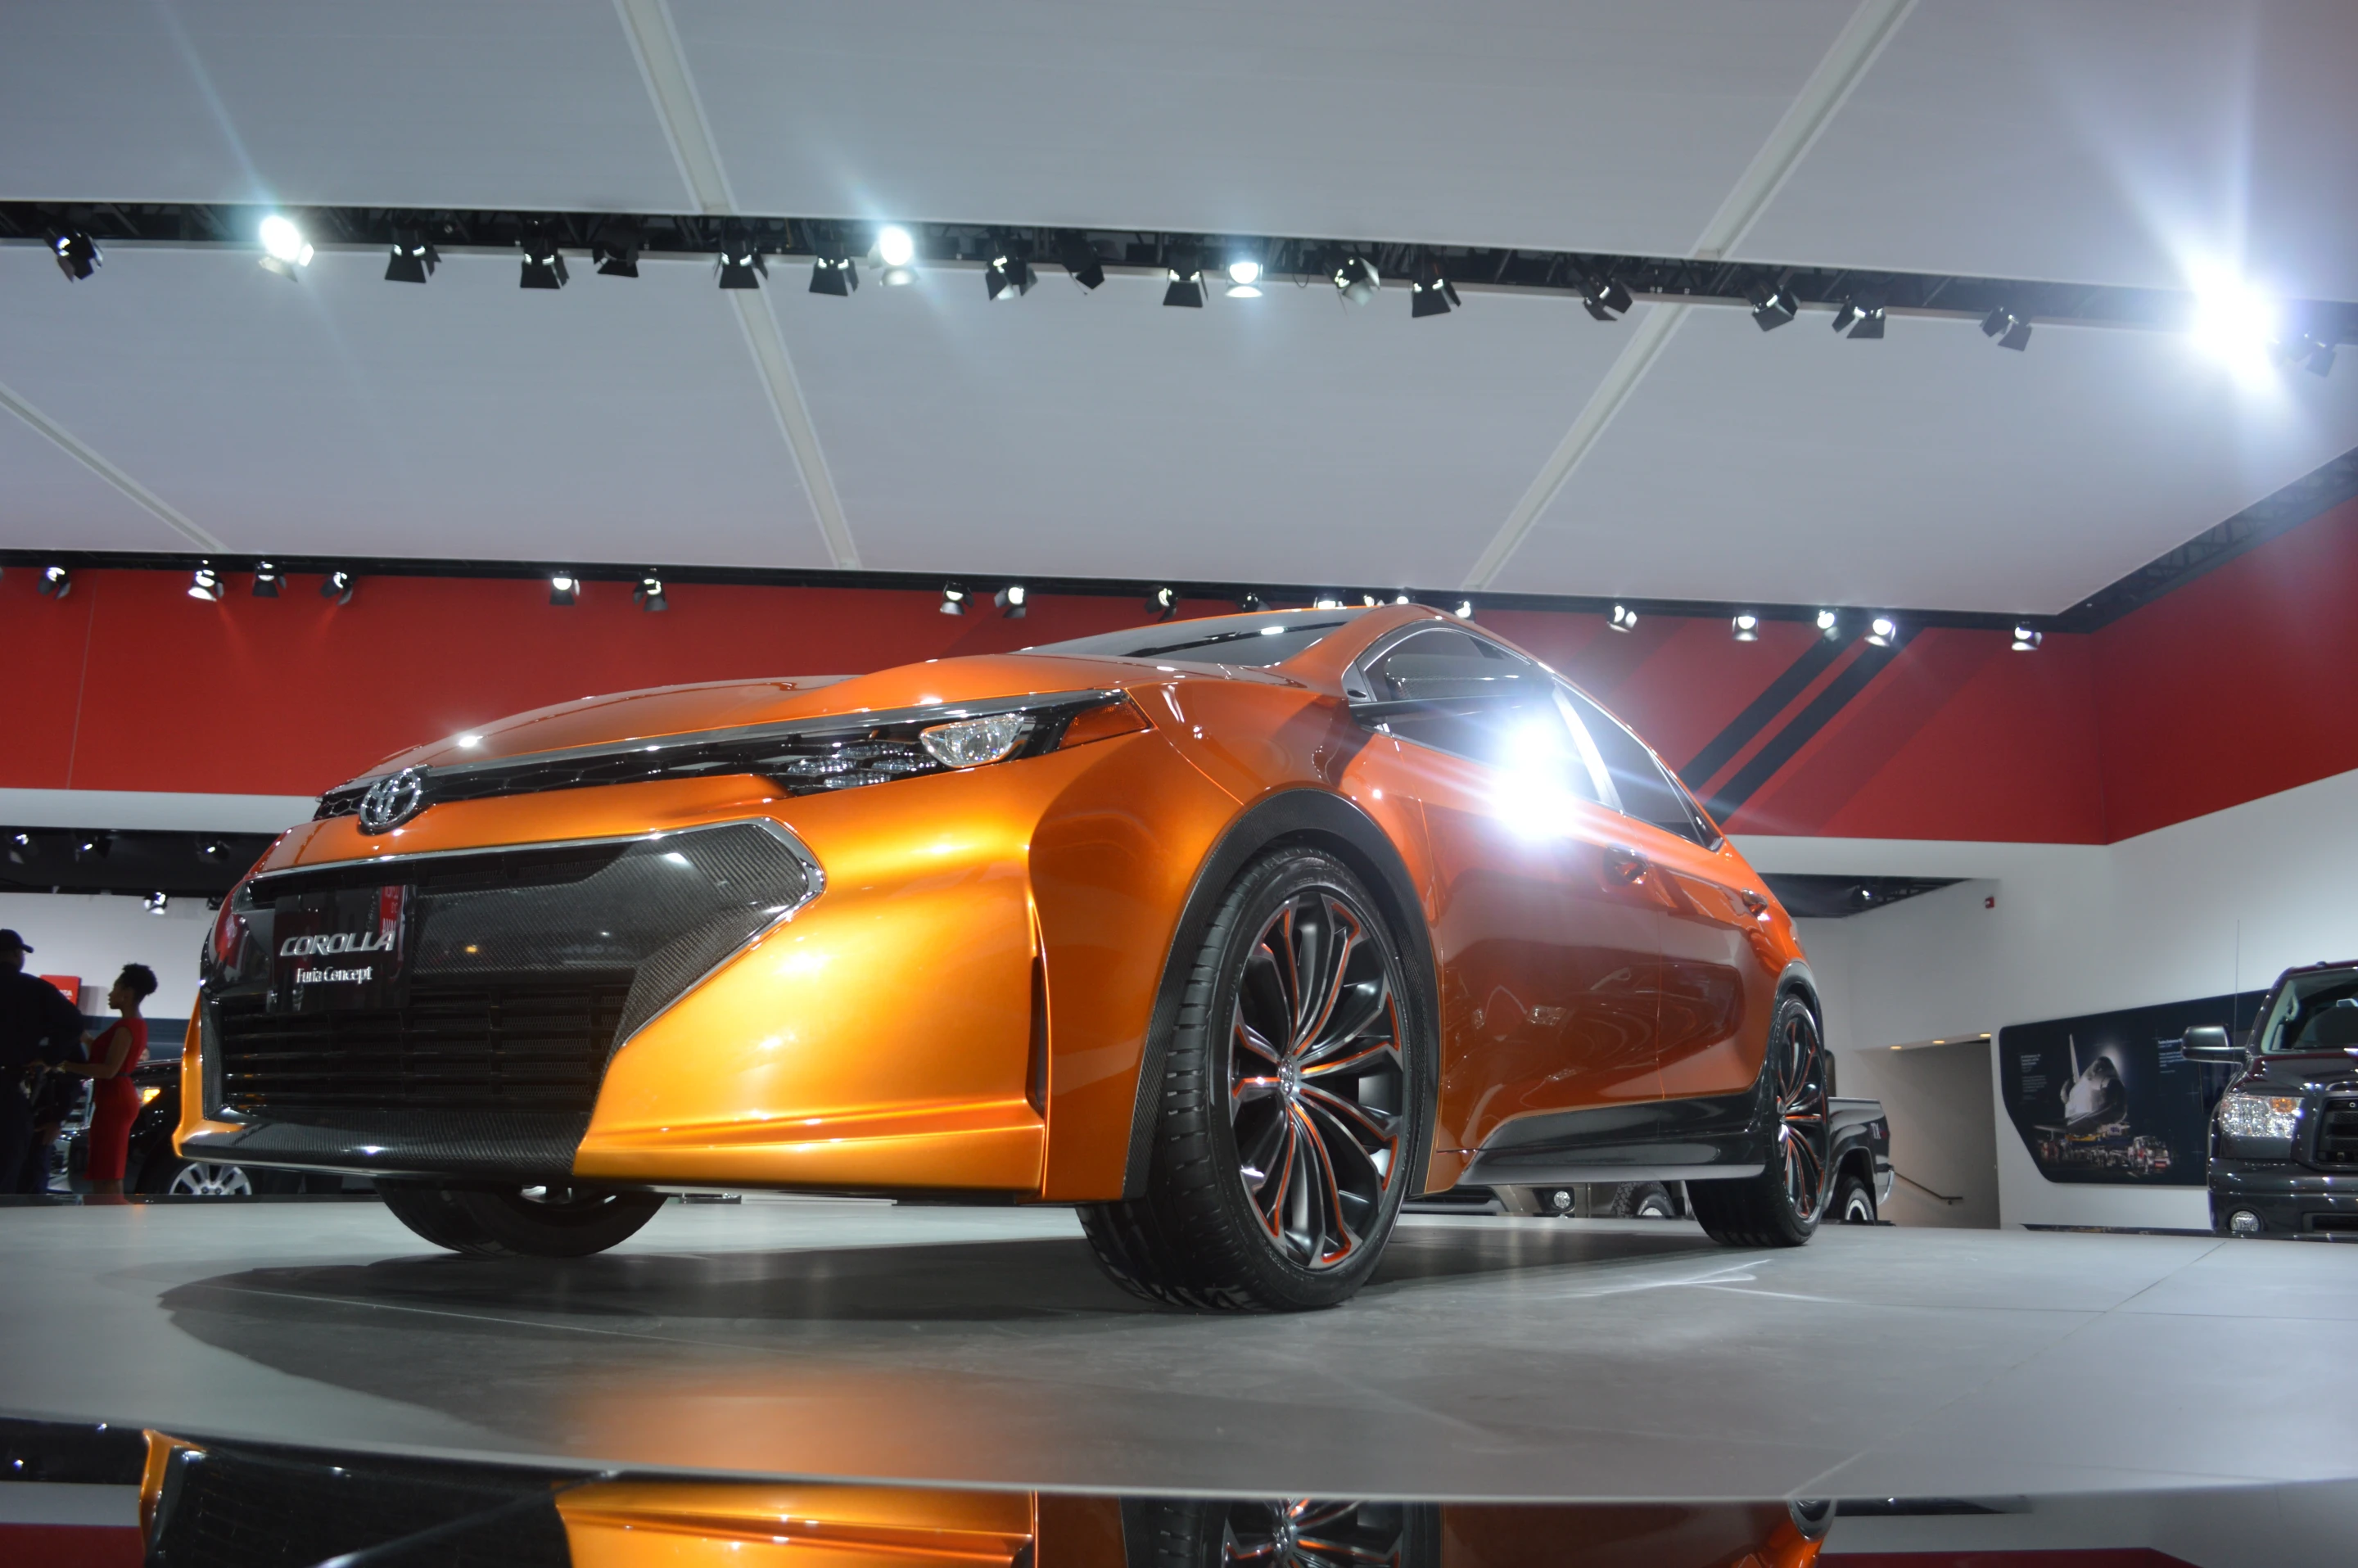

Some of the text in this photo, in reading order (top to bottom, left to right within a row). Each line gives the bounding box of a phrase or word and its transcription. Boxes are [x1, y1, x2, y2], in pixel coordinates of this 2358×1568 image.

[280, 932, 396, 956] COROLLA
[296, 966, 373, 984] Furia Concept
